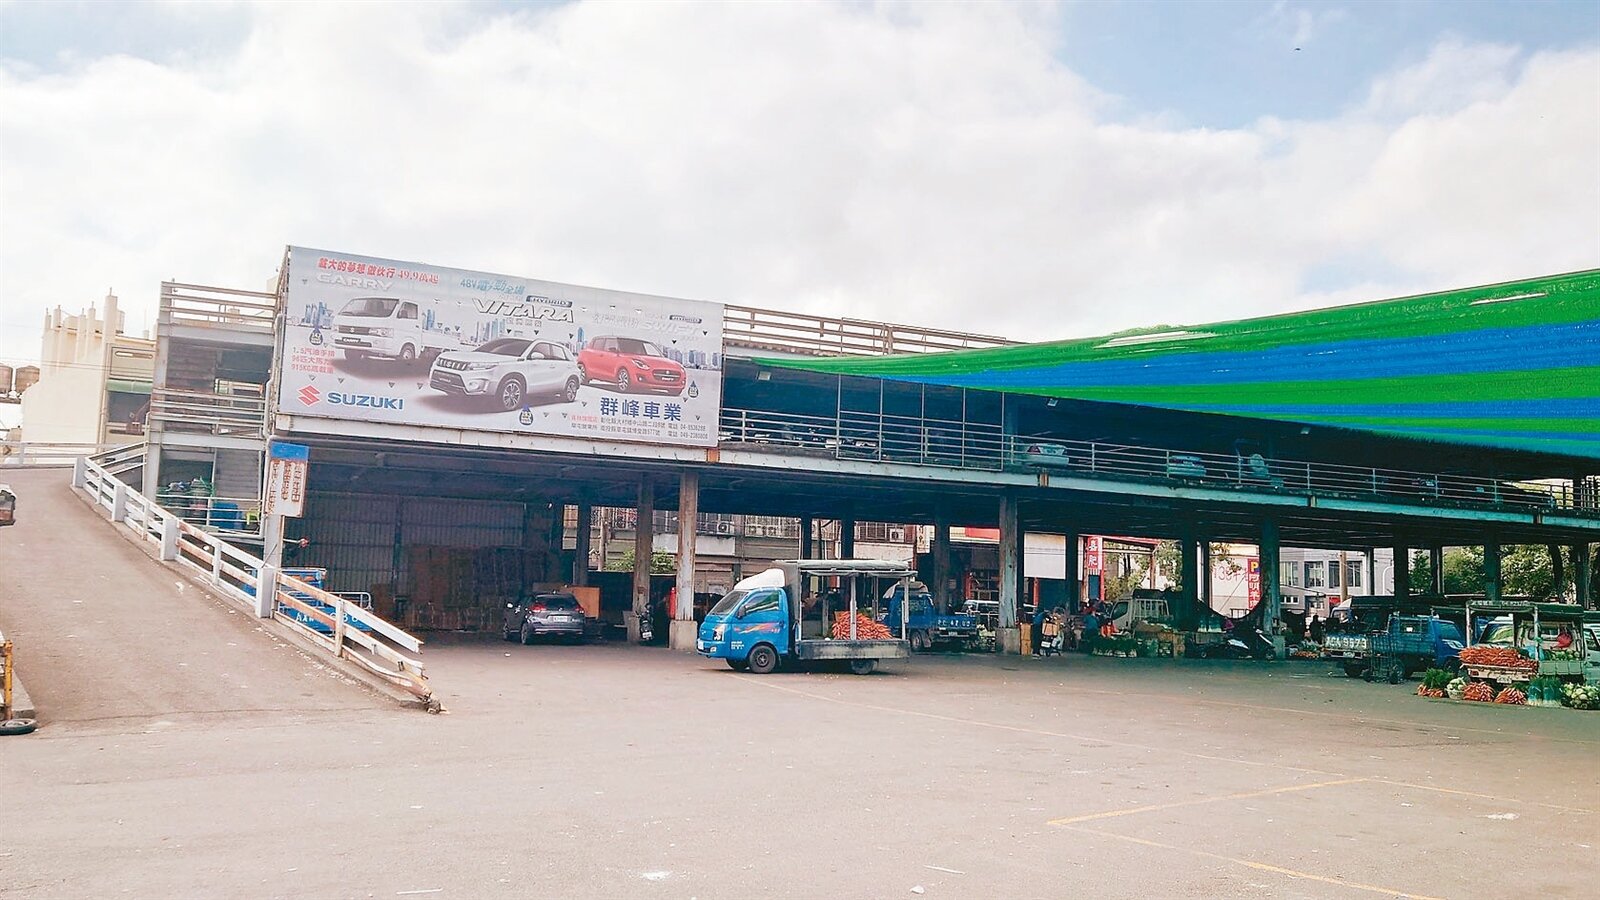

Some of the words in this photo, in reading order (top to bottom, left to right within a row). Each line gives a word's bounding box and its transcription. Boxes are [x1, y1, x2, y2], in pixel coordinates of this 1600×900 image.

[316, 272, 394, 292] CARRY
[472, 298, 574, 323] VITARA
[327, 392, 404, 410] SUZUKI
[600, 397, 682, 421] 群峰車業
